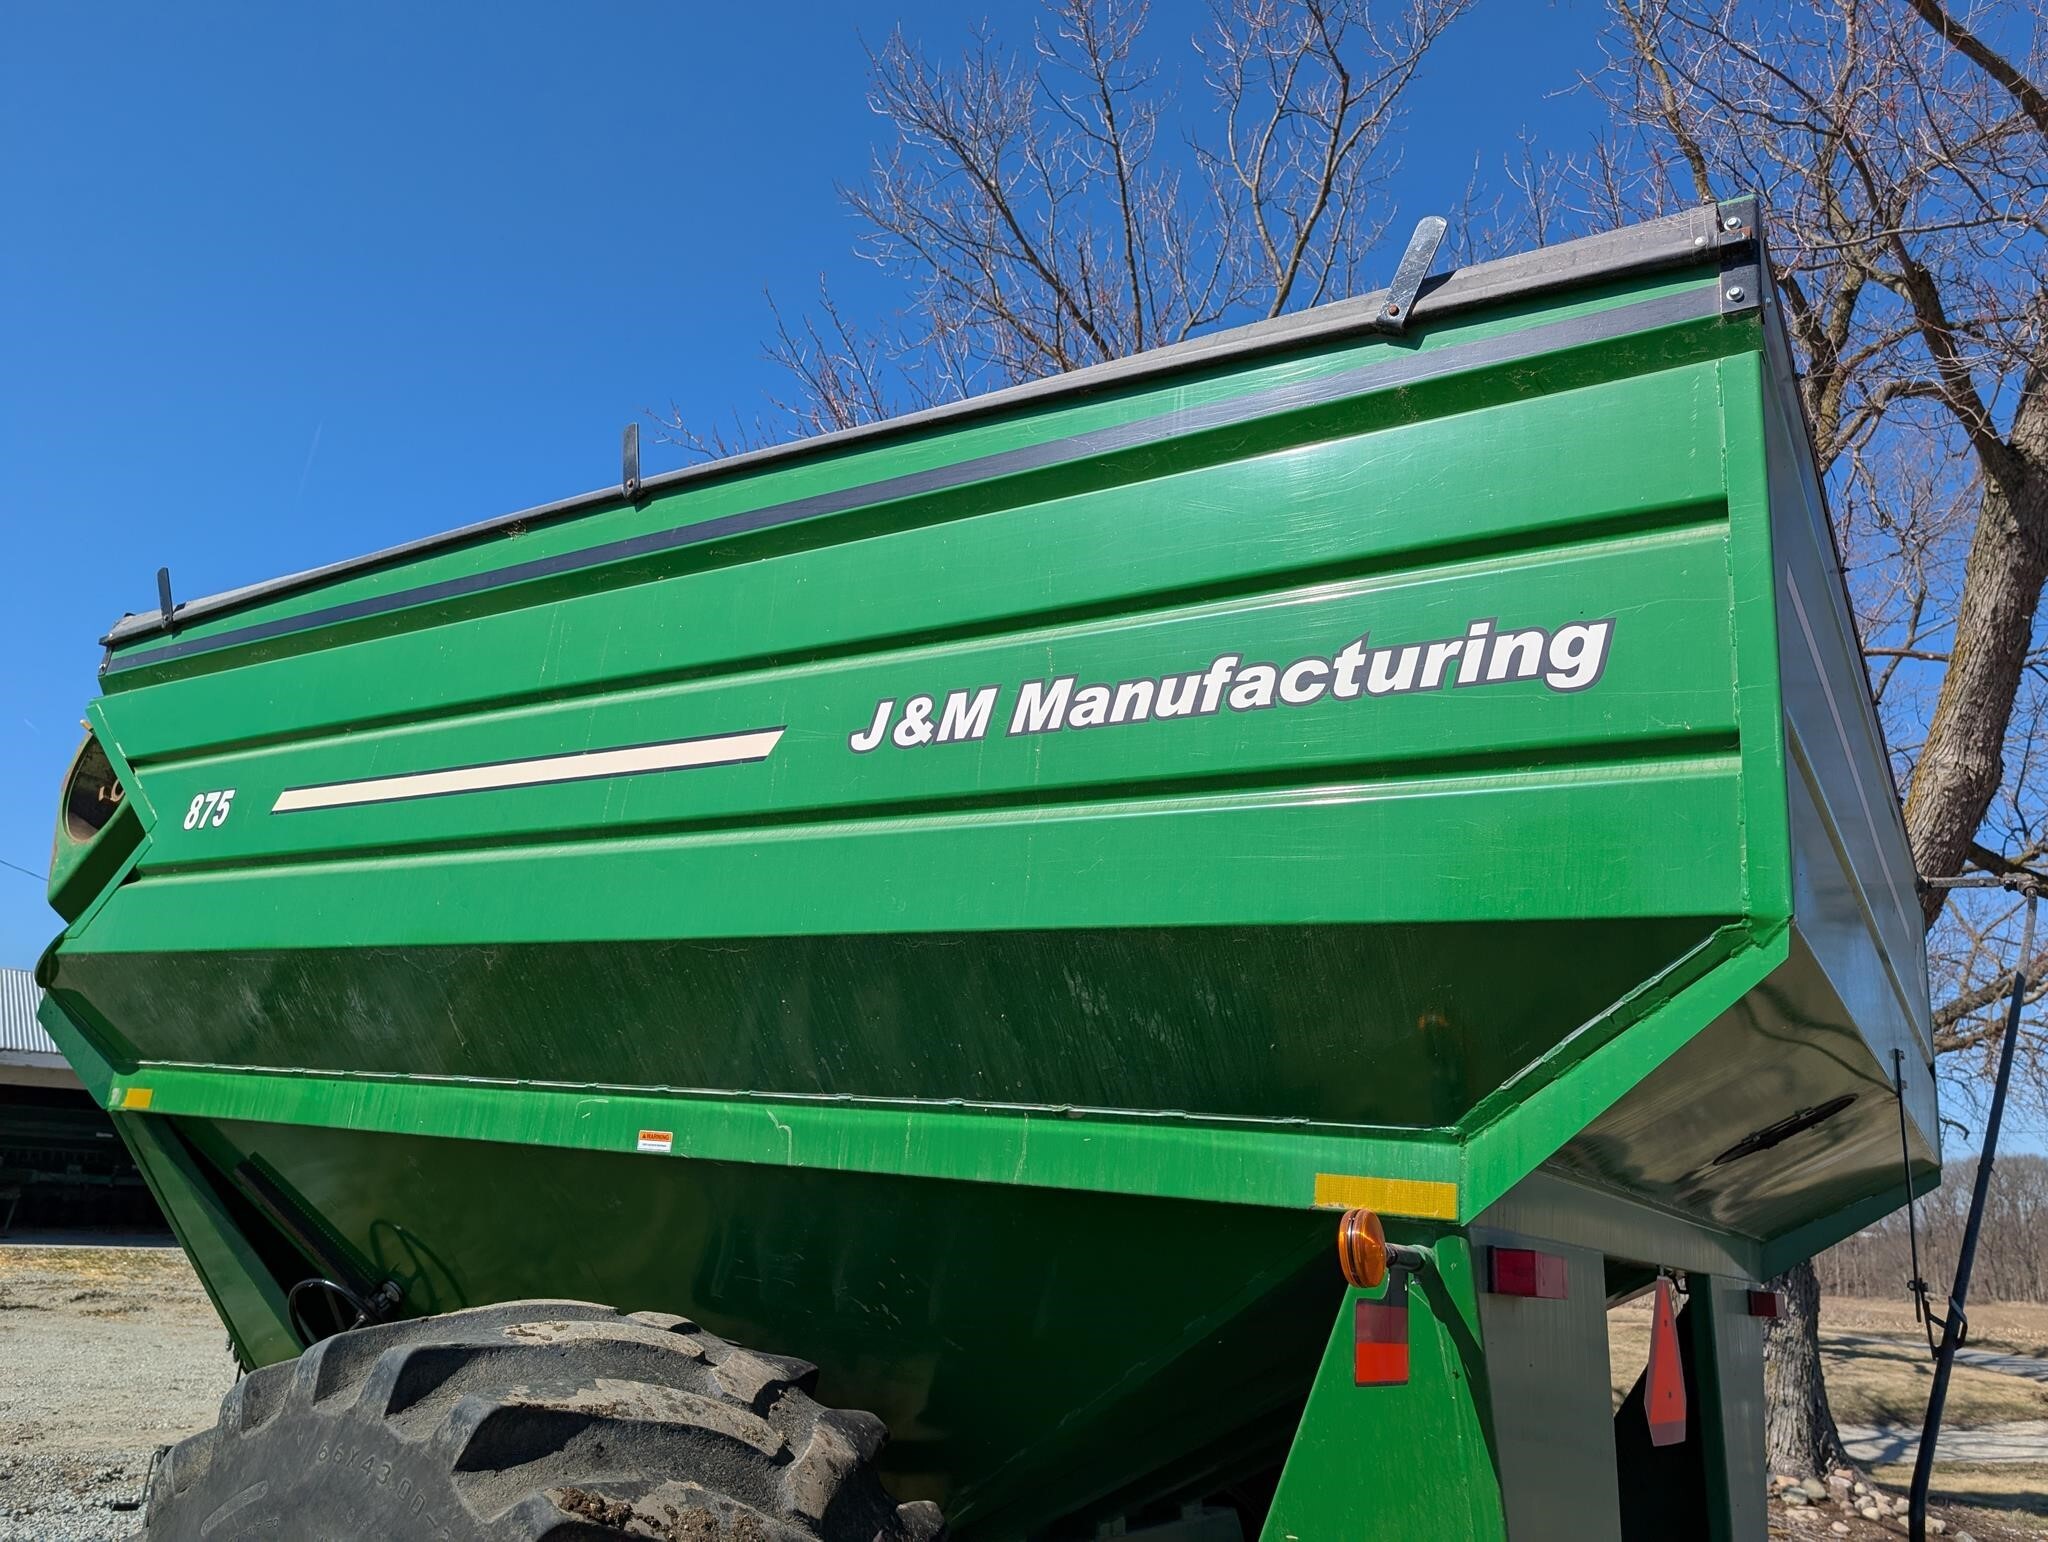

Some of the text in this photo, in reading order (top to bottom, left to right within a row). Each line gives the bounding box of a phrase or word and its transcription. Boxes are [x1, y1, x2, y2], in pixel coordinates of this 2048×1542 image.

[849, 617, 1615, 752] J&M Manufacturing
[182, 787, 237, 831] 875
